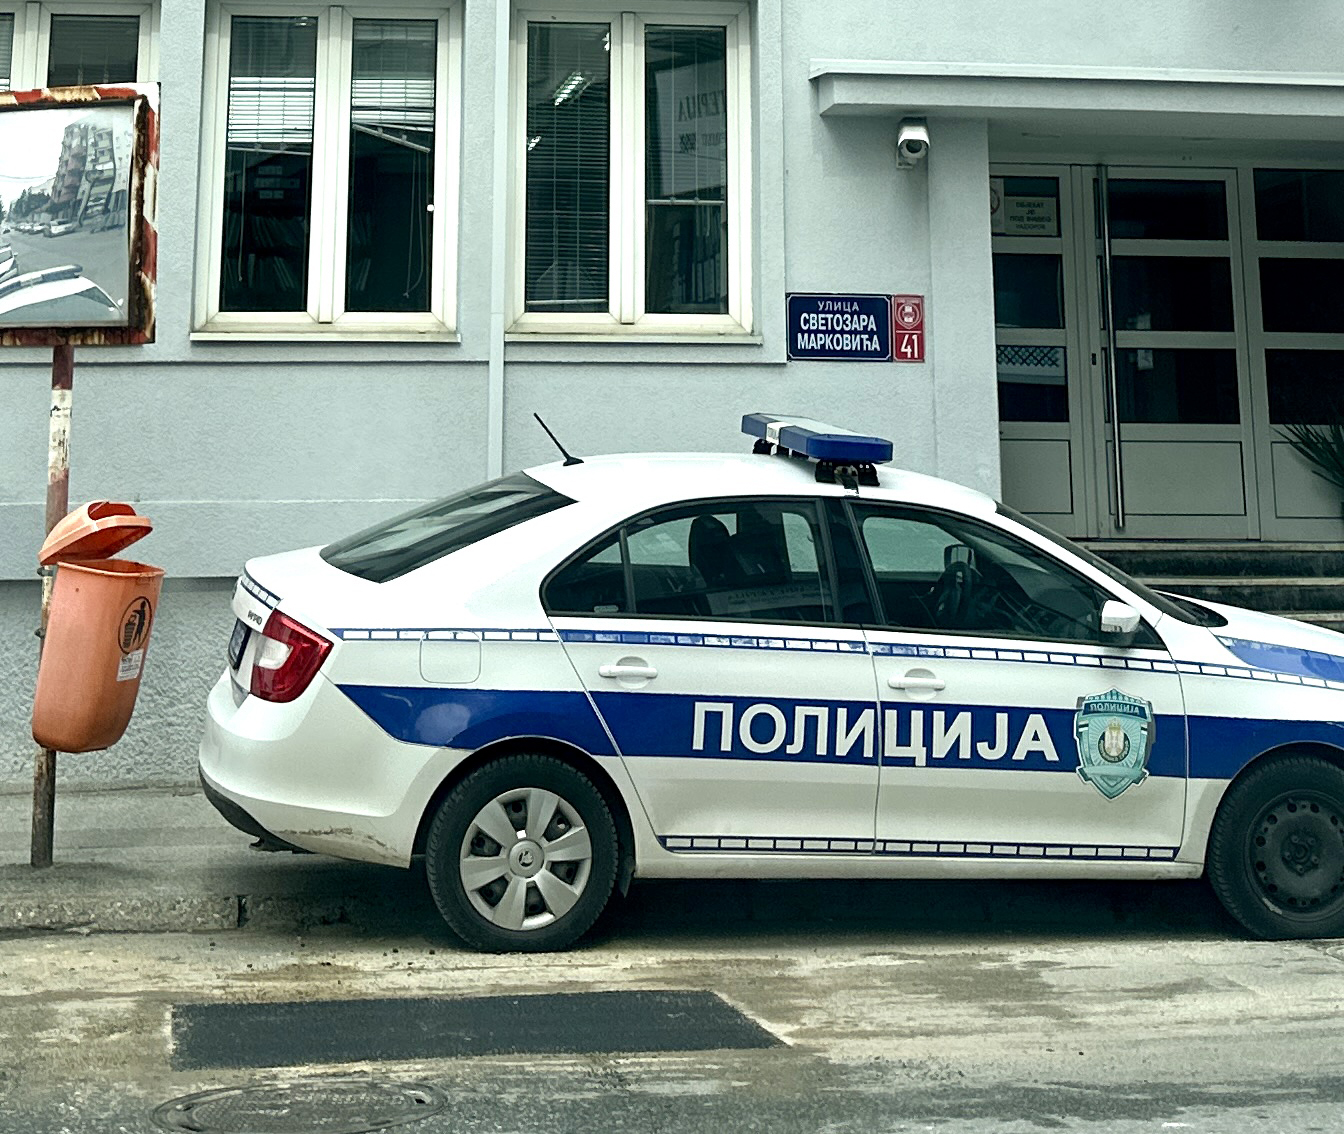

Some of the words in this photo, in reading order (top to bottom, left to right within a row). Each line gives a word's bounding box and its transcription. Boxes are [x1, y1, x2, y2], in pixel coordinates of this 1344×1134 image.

[817, 300, 860, 312] УЛИЦА
[800, 313, 877, 332] СВЕТОЗАРА
[797, 333, 881, 352] МАРКОВИЋА
[900, 334, 919, 359] 41
[1090, 702, 1140, 714] ПОЛИЦИЈА
[692, 701, 1060, 767] ПОЛИЦИЈА
